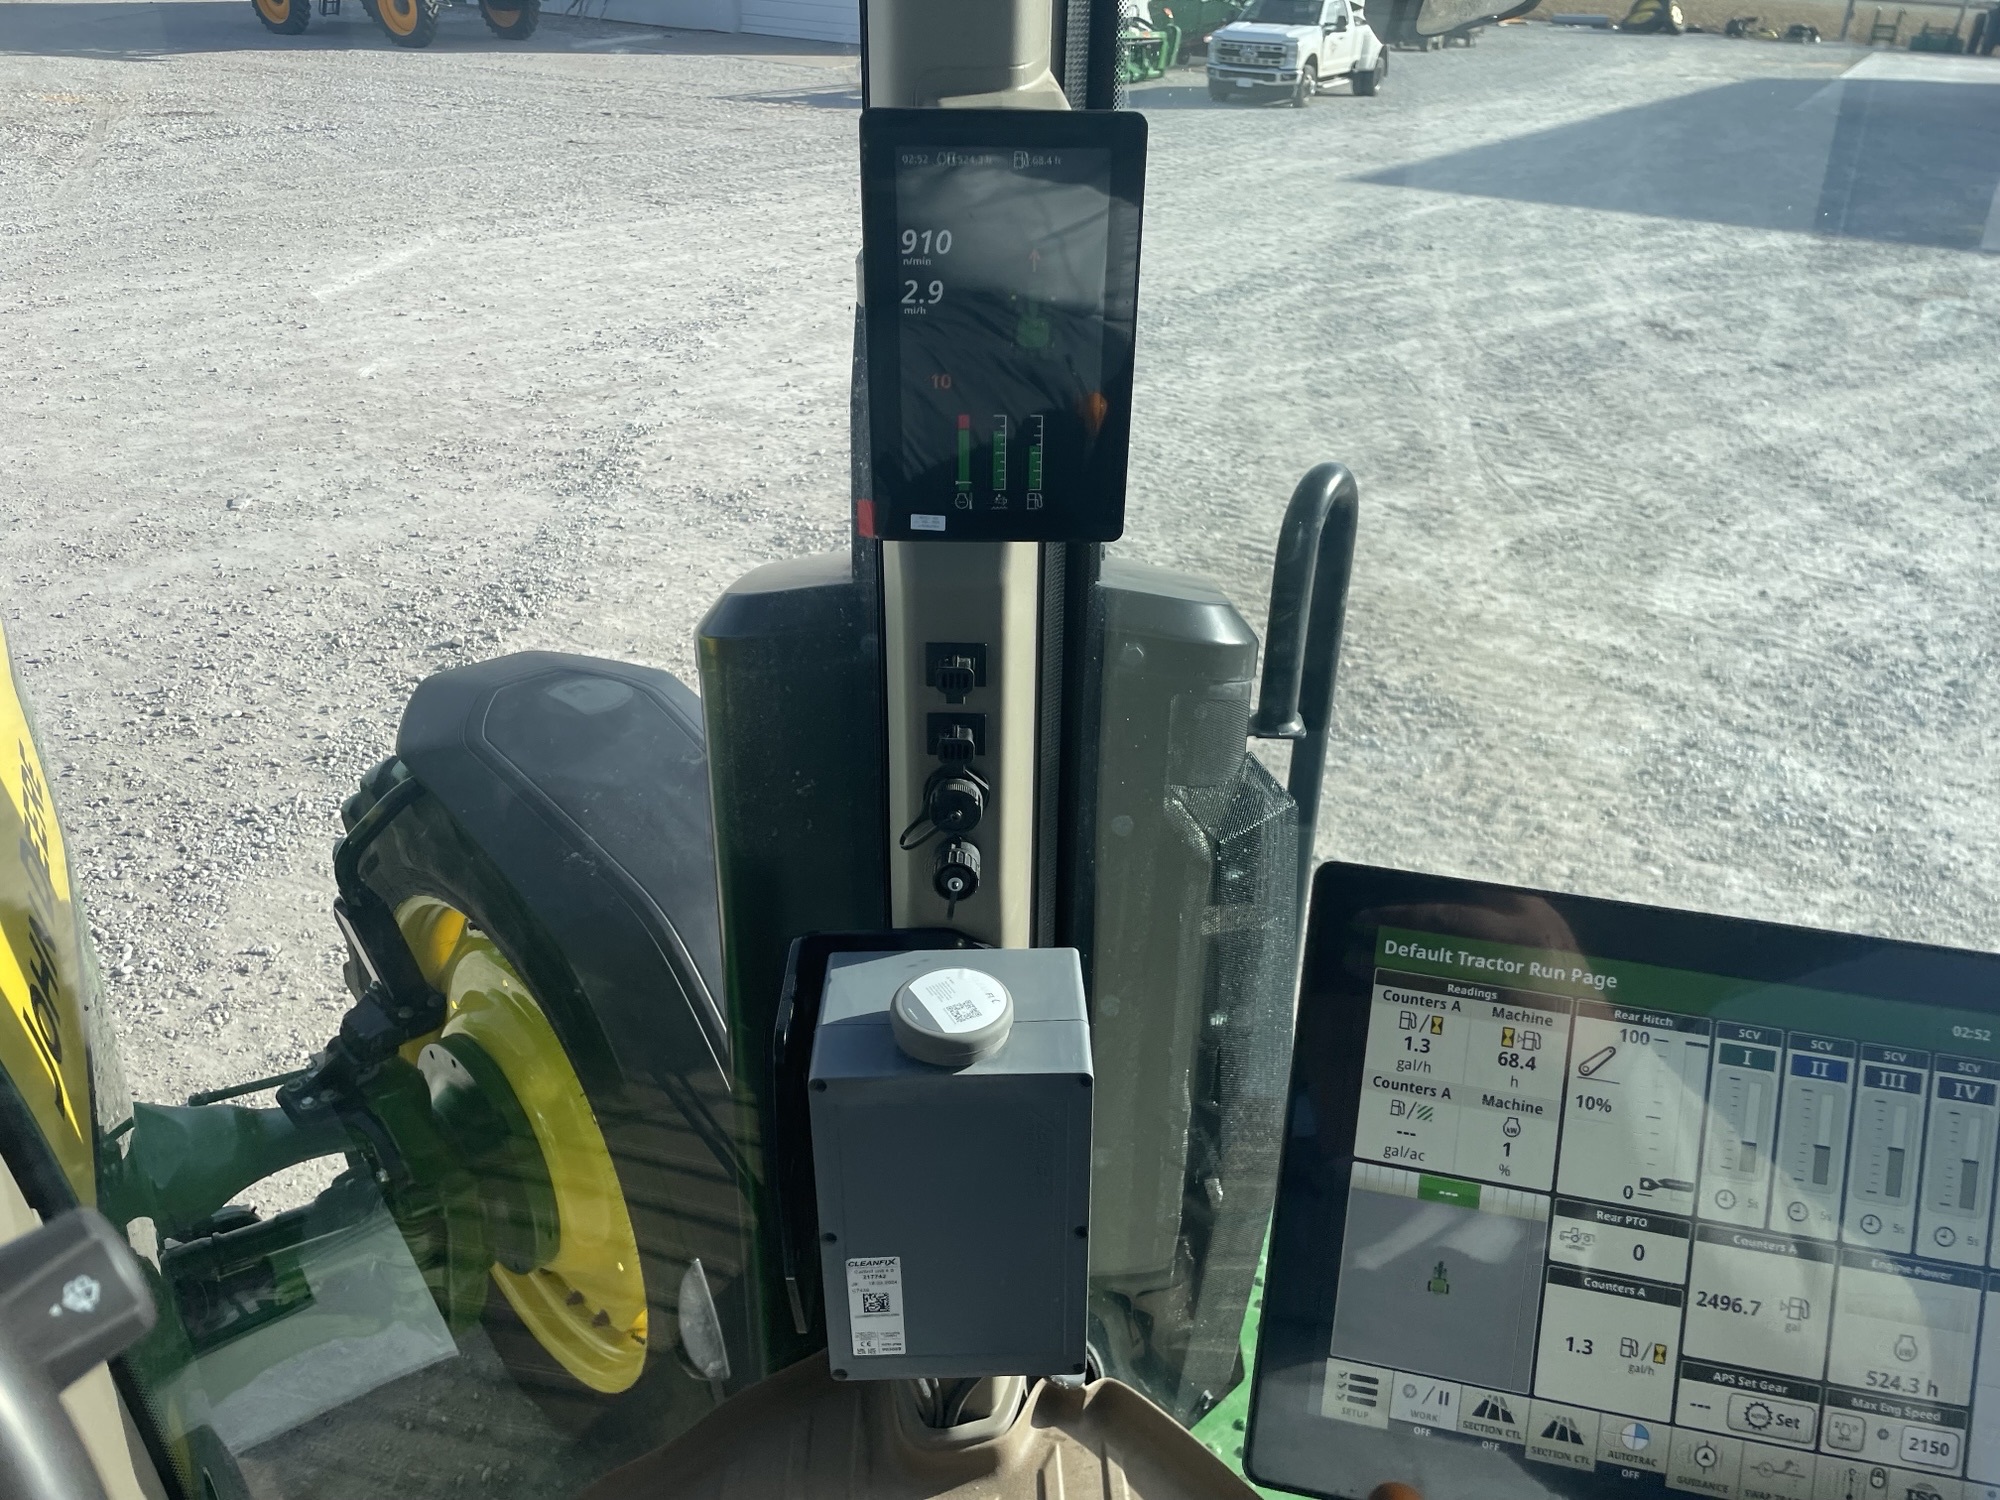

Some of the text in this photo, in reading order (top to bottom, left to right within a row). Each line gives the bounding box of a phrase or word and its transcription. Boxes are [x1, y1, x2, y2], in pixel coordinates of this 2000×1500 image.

[900, 228, 953, 255] 910
[902, 255, 933, 267] n/min
[900, 279, 945, 305] 2.9
[903, 304, 927, 316] mi/h
[931, 373, 953, 390] 10
[1384, 939, 1619, 990] Default Tractor Run Page
[1382, 989, 1462, 1013] Counters A
[1447, 983, 1498, 1001] Readings
[23, 892, 65, 1120] JOHN
[1491, 1006, 1554, 1027] Machine
[1613, 1009, 1674, 1028] Rear Hitch
[1620, 1028, 1651, 1046] 100
[1738, 1028, 1762, 1041] SCV
[1951, 1025, 1992, 1042] 02:52
[1403, 1036, 1432, 1054] 1.3
[1810, 1039, 1834, 1051] SCV
[1395, 1057, 1432, 1074] gal/h
[1497, 1051, 1537, 1071] 68.4
[1883, 1050, 1908, 1063] SCV
[1810, 1062, 1830, 1077] II
[1957, 1061, 1982, 1074] SCV
[1372, 1075, 1452, 1100] Counters A
[1510, 1075, 1519, 1089] h
[1879, 1071, 1907, 1090] III
[1953, 1083, 1981, 1100] IV
[1481, 1094, 1544, 1116] Machine
[1575, 1094, 1613, 1114] 10%
[1382, 1144, 1426, 1162] gal/ac
[1502, 1141, 1512, 1158] 1
[1498, 1163, 1511, 1177] %
[1622, 1185, 1634, 1200] 0
[1596, 1209, 1648, 1228] Rear PTO
[1632, 1244, 1645, 1261] 0
[1732, 1234, 1798, 1256] Counters A
[848, 1258, 896, 1267] CLEANFIX
[1915, 1266, 1954, 1281] Power
[1583, 1276, 1647, 1298] Counters A
[1695, 1290, 1762, 1317] 2496.7
[1564, 1336, 1594, 1356] 1.3
[1627, 1361, 1656, 1377] gal/h
[1712, 1371, 1789, 1394] APS Set Gear
[1865, 1370, 1939, 1398] 524.3 h
[1340, 1405, 1370, 1420] SETUP
[1409, 1408, 1439, 1424] WORK
[1851, 1397, 1942, 1422] Max Eng Speed
[1462, 1420, 1523, 1441] SECTION CTL
[1775, 1413, 1801, 1430] Set
[1413, 1426, 1432, 1438] OFF
[1481, 1440, 1501, 1452] OFF
[1908, 1437, 1951, 1457] 2150
[1530, 1445, 1591, 1466] SECTION CTL
[1607, 1449, 1659, 1468] AUTOTRAC
[1621, 1468, 1640, 1480] OFF
[1676, 1474, 1731, 1494] GUIDANCE
